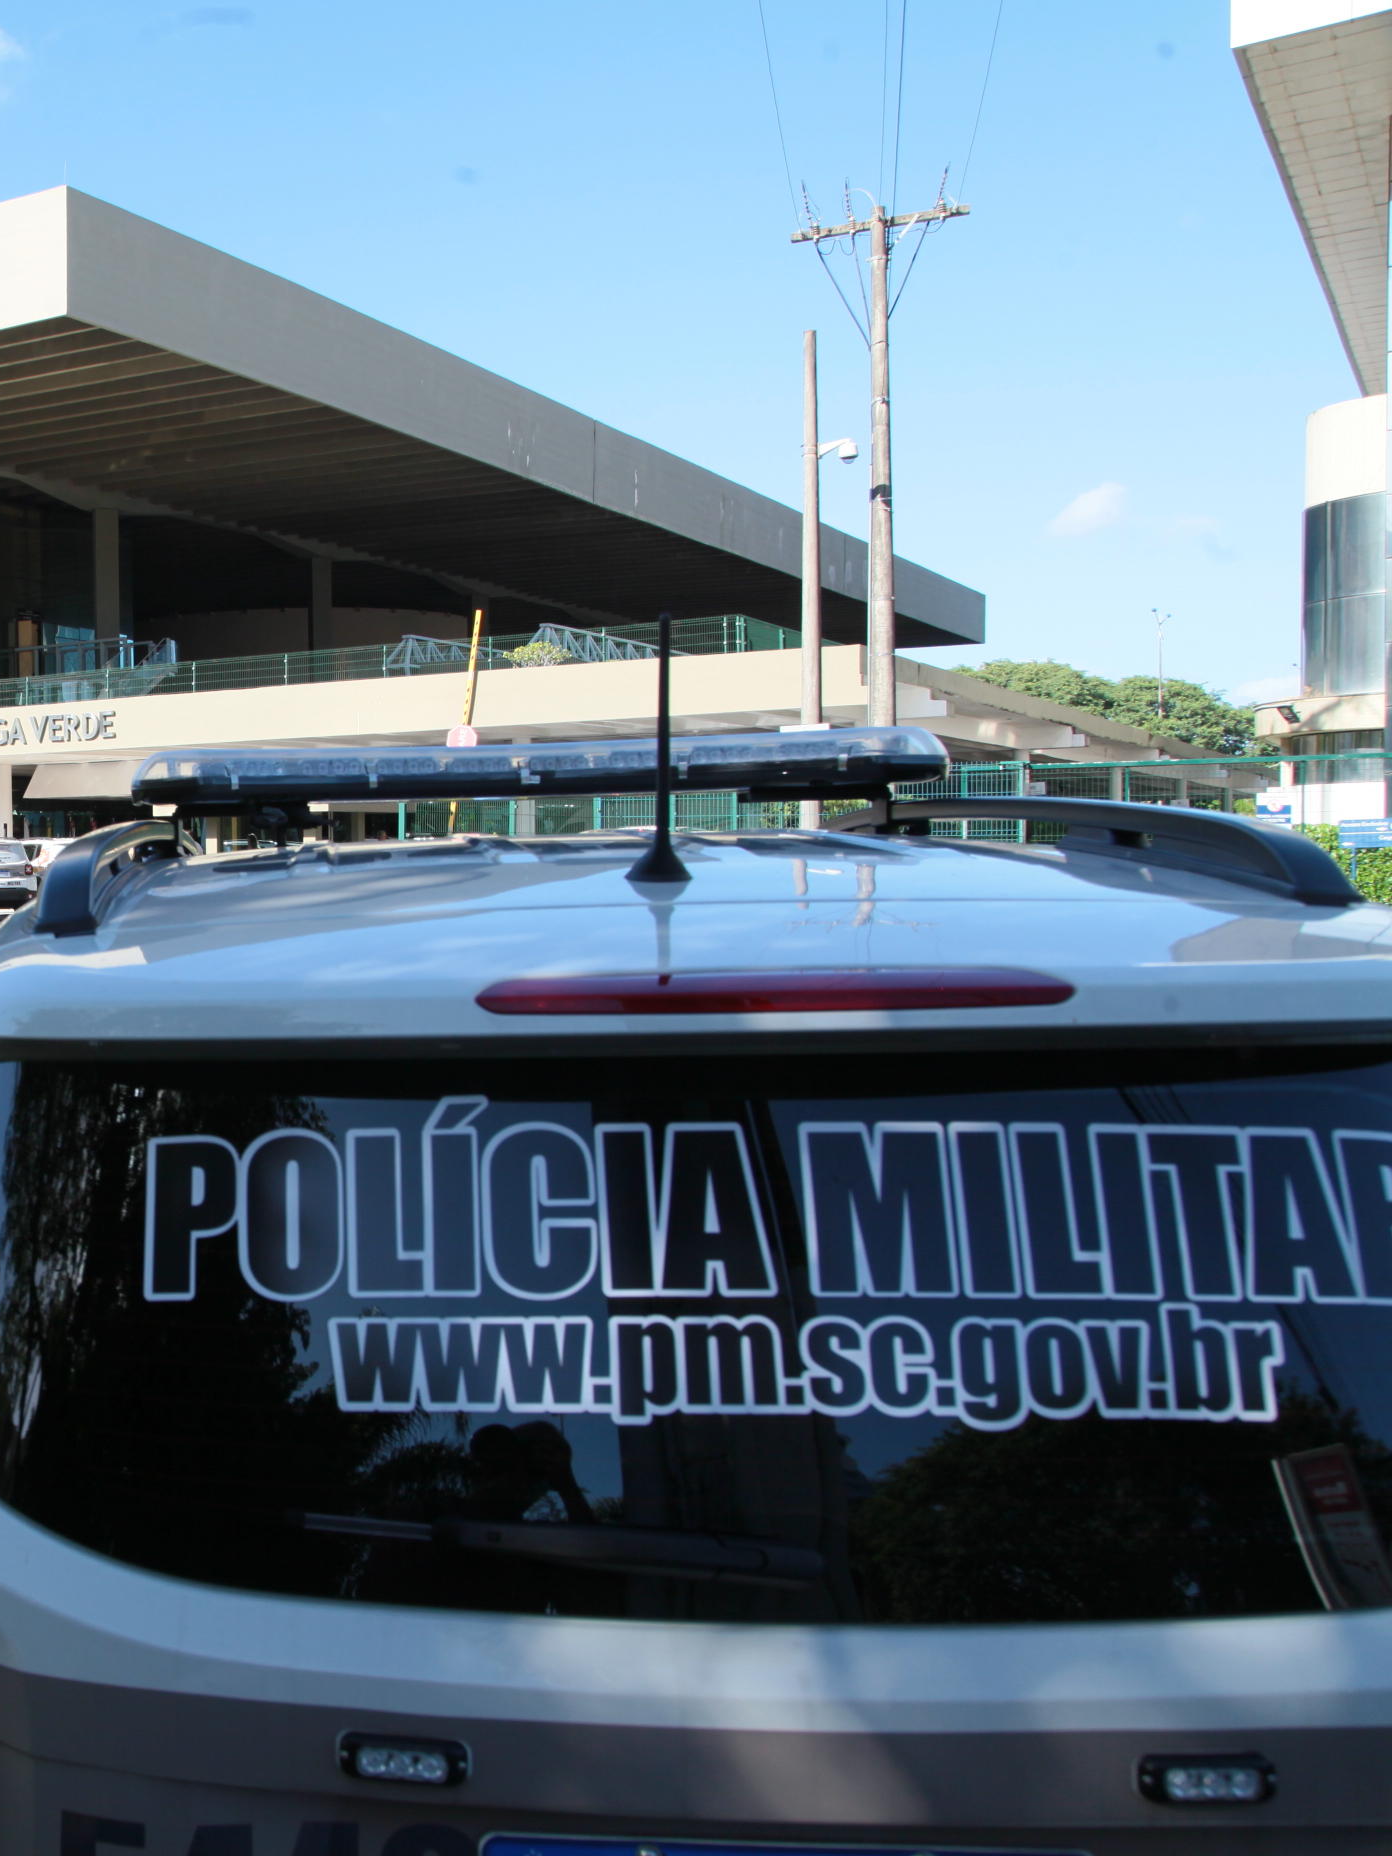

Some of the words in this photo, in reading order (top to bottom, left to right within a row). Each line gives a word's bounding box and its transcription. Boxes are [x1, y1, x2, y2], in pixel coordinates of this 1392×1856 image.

[29, 710, 116, 744] VERDE
[143, 1095, 779, 1303] POLÍCIA
[328, 1302, 1285, 1432] www.pm.sc.gov.br
